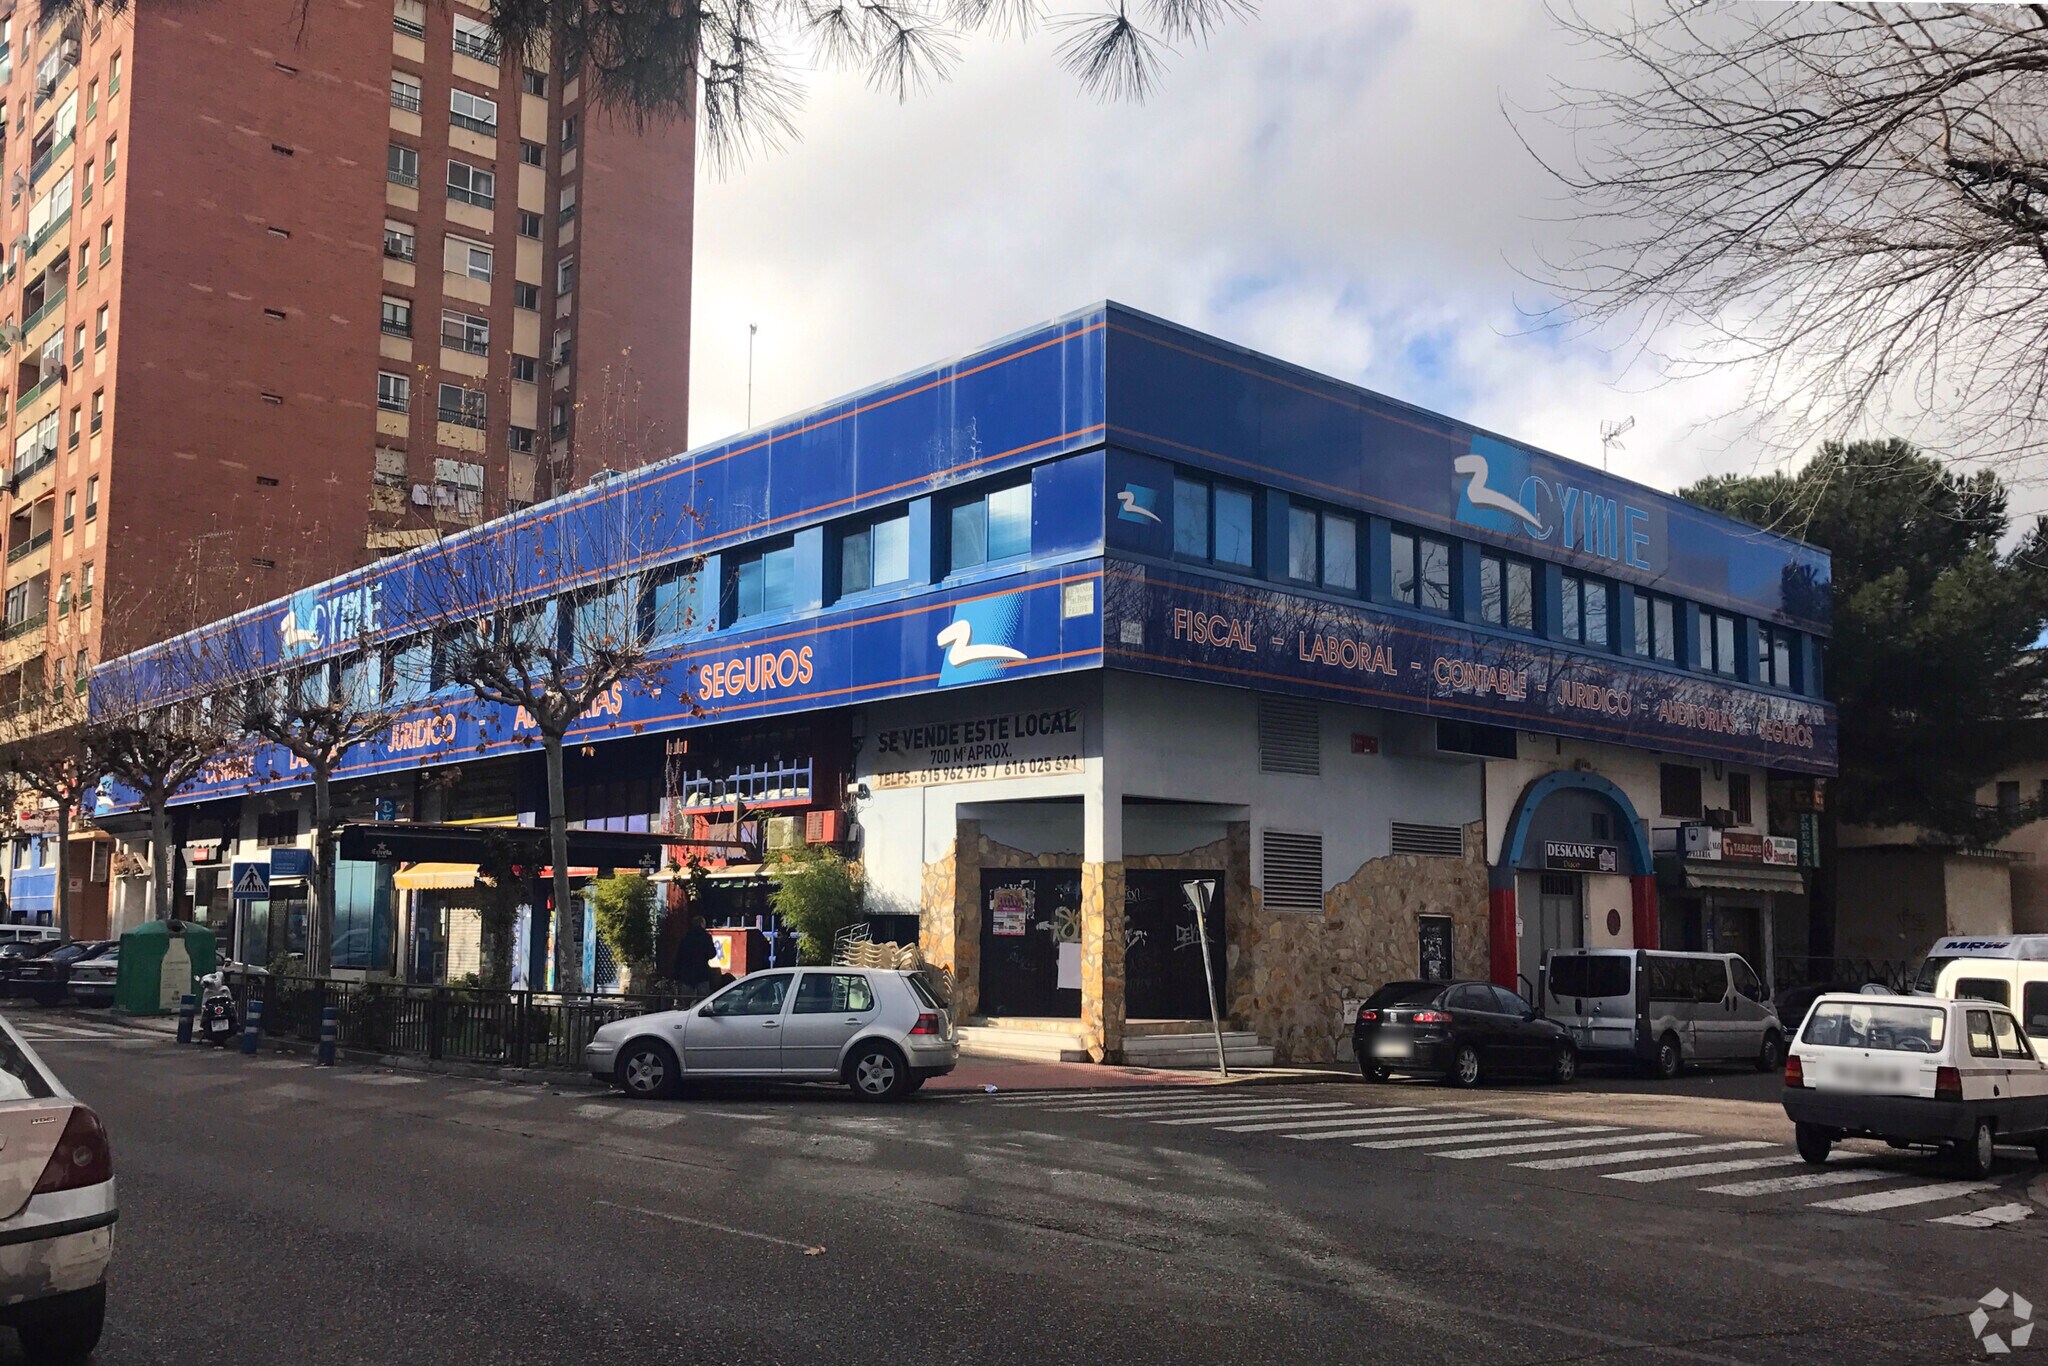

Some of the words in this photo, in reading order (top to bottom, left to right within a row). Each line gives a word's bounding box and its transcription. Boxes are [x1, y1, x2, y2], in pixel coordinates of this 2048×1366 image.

[1519, 475, 1649, 571] CYME
[308, 582, 382, 650] CYME
[388, 713, 456, 753] JURIDICO
[699, 646, 813, 700] SEGUROS
[1174, 608, 1256, 652] FISCAL
[1300, 631, 1397, 676] LABORAL
[1434, 656, 1526, 698] CONTABLE
[1558, 680, 1632, 717] JURIDICO
[1659, 699, 1737, 735] AUDITORIAS
[1759, 718, 1813, 749] SEGUROS
[878, 731, 899, 753] SE
[903, 723, 959, 750] VENDE
[964, 716, 1009, 743] ESTE
[1014, 708, 1076, 738] LOCAL
[920, 768, 939, 783] 615
[944, 766, 963, 781] 962
[967, 763, 987, 779] 975
[1005, 758, 1025, 776] 616
[1030, 756, 1051, 774] 025
[1055, 754, 1077, 771] 691
[931, 749, 949, 765] 700
[968, 742, 1012, 762] APROX.
[1547, 843, 1595, 859] DESKANSE
[1733, 842, 1761, 855] TABACOS
[1801, 813, 1811, 867] PRENSA
[1944, 941, 2010, 950] MRW
